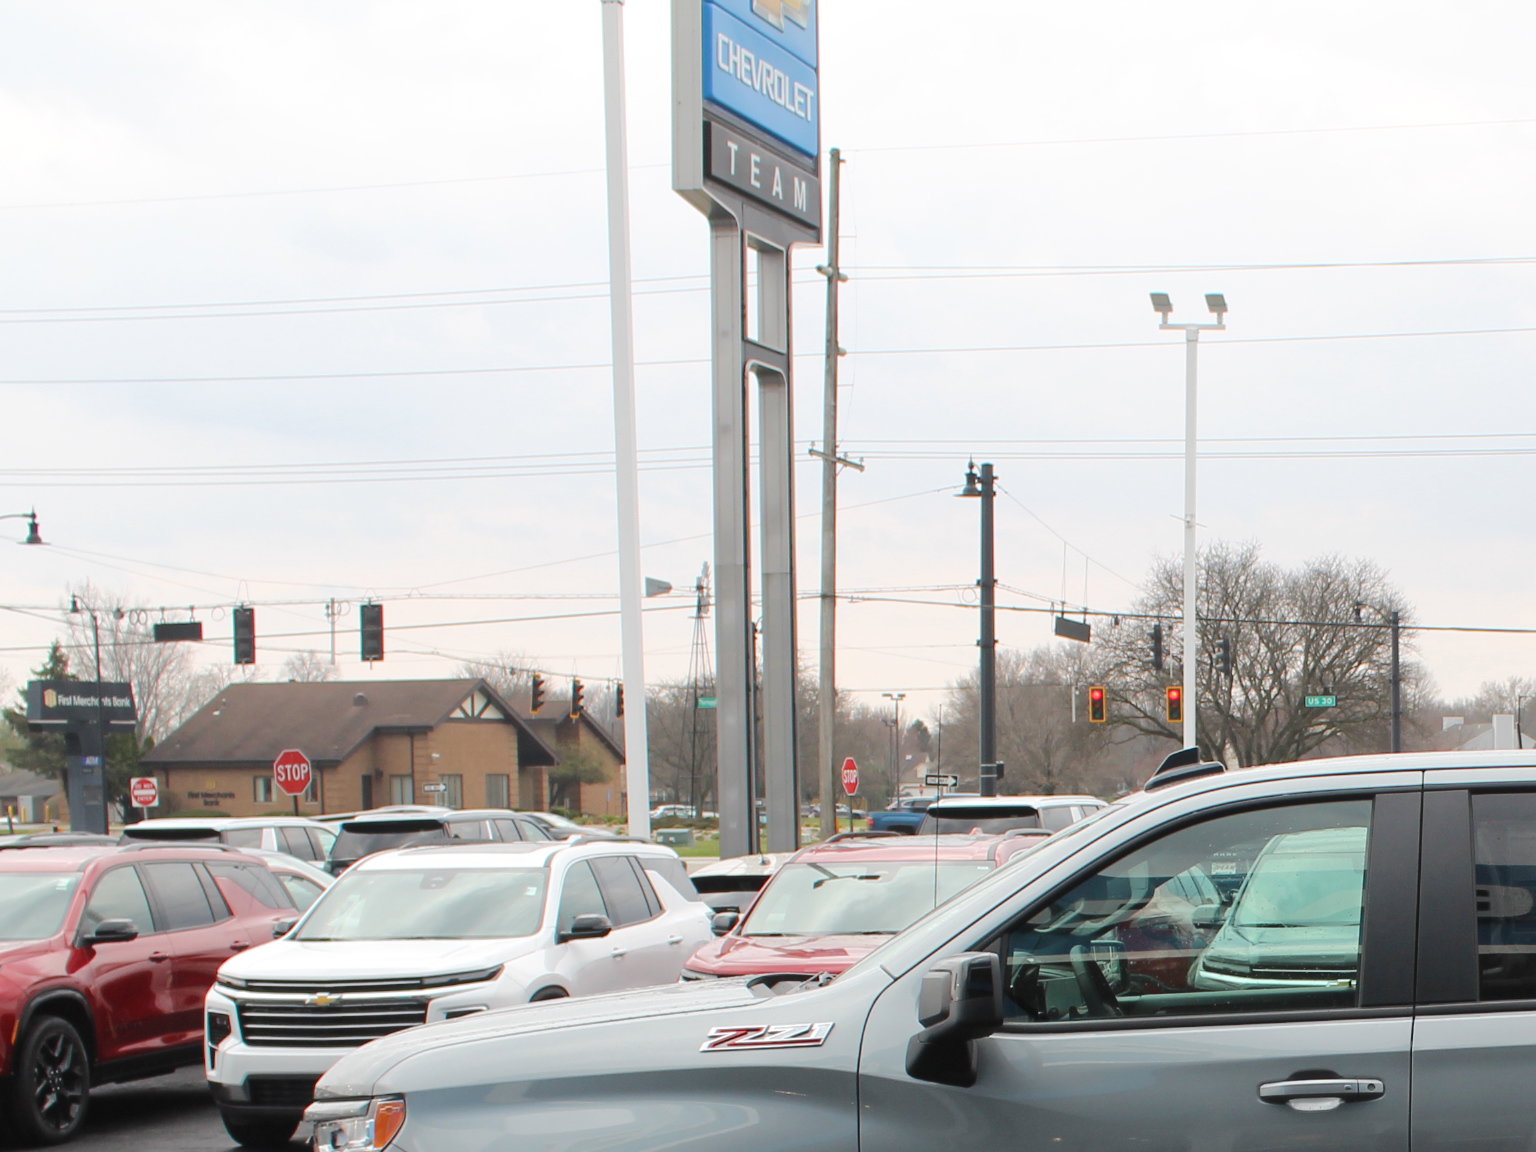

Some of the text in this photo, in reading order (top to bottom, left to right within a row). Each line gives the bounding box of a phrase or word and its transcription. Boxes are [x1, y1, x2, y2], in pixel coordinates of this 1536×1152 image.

[717, 32, 814, 121] CHEVROLET
[727, 141, 807, 212] TEAM
[57, 694, 72, 706] First
[112, 696, 131, 707] Bank
[1308, 697, 1319, 705] US
[277, 763, 309, 782] STOP
[843, 769, 857, 783] STOP
[699, 1022, 835, 1052] Z71
